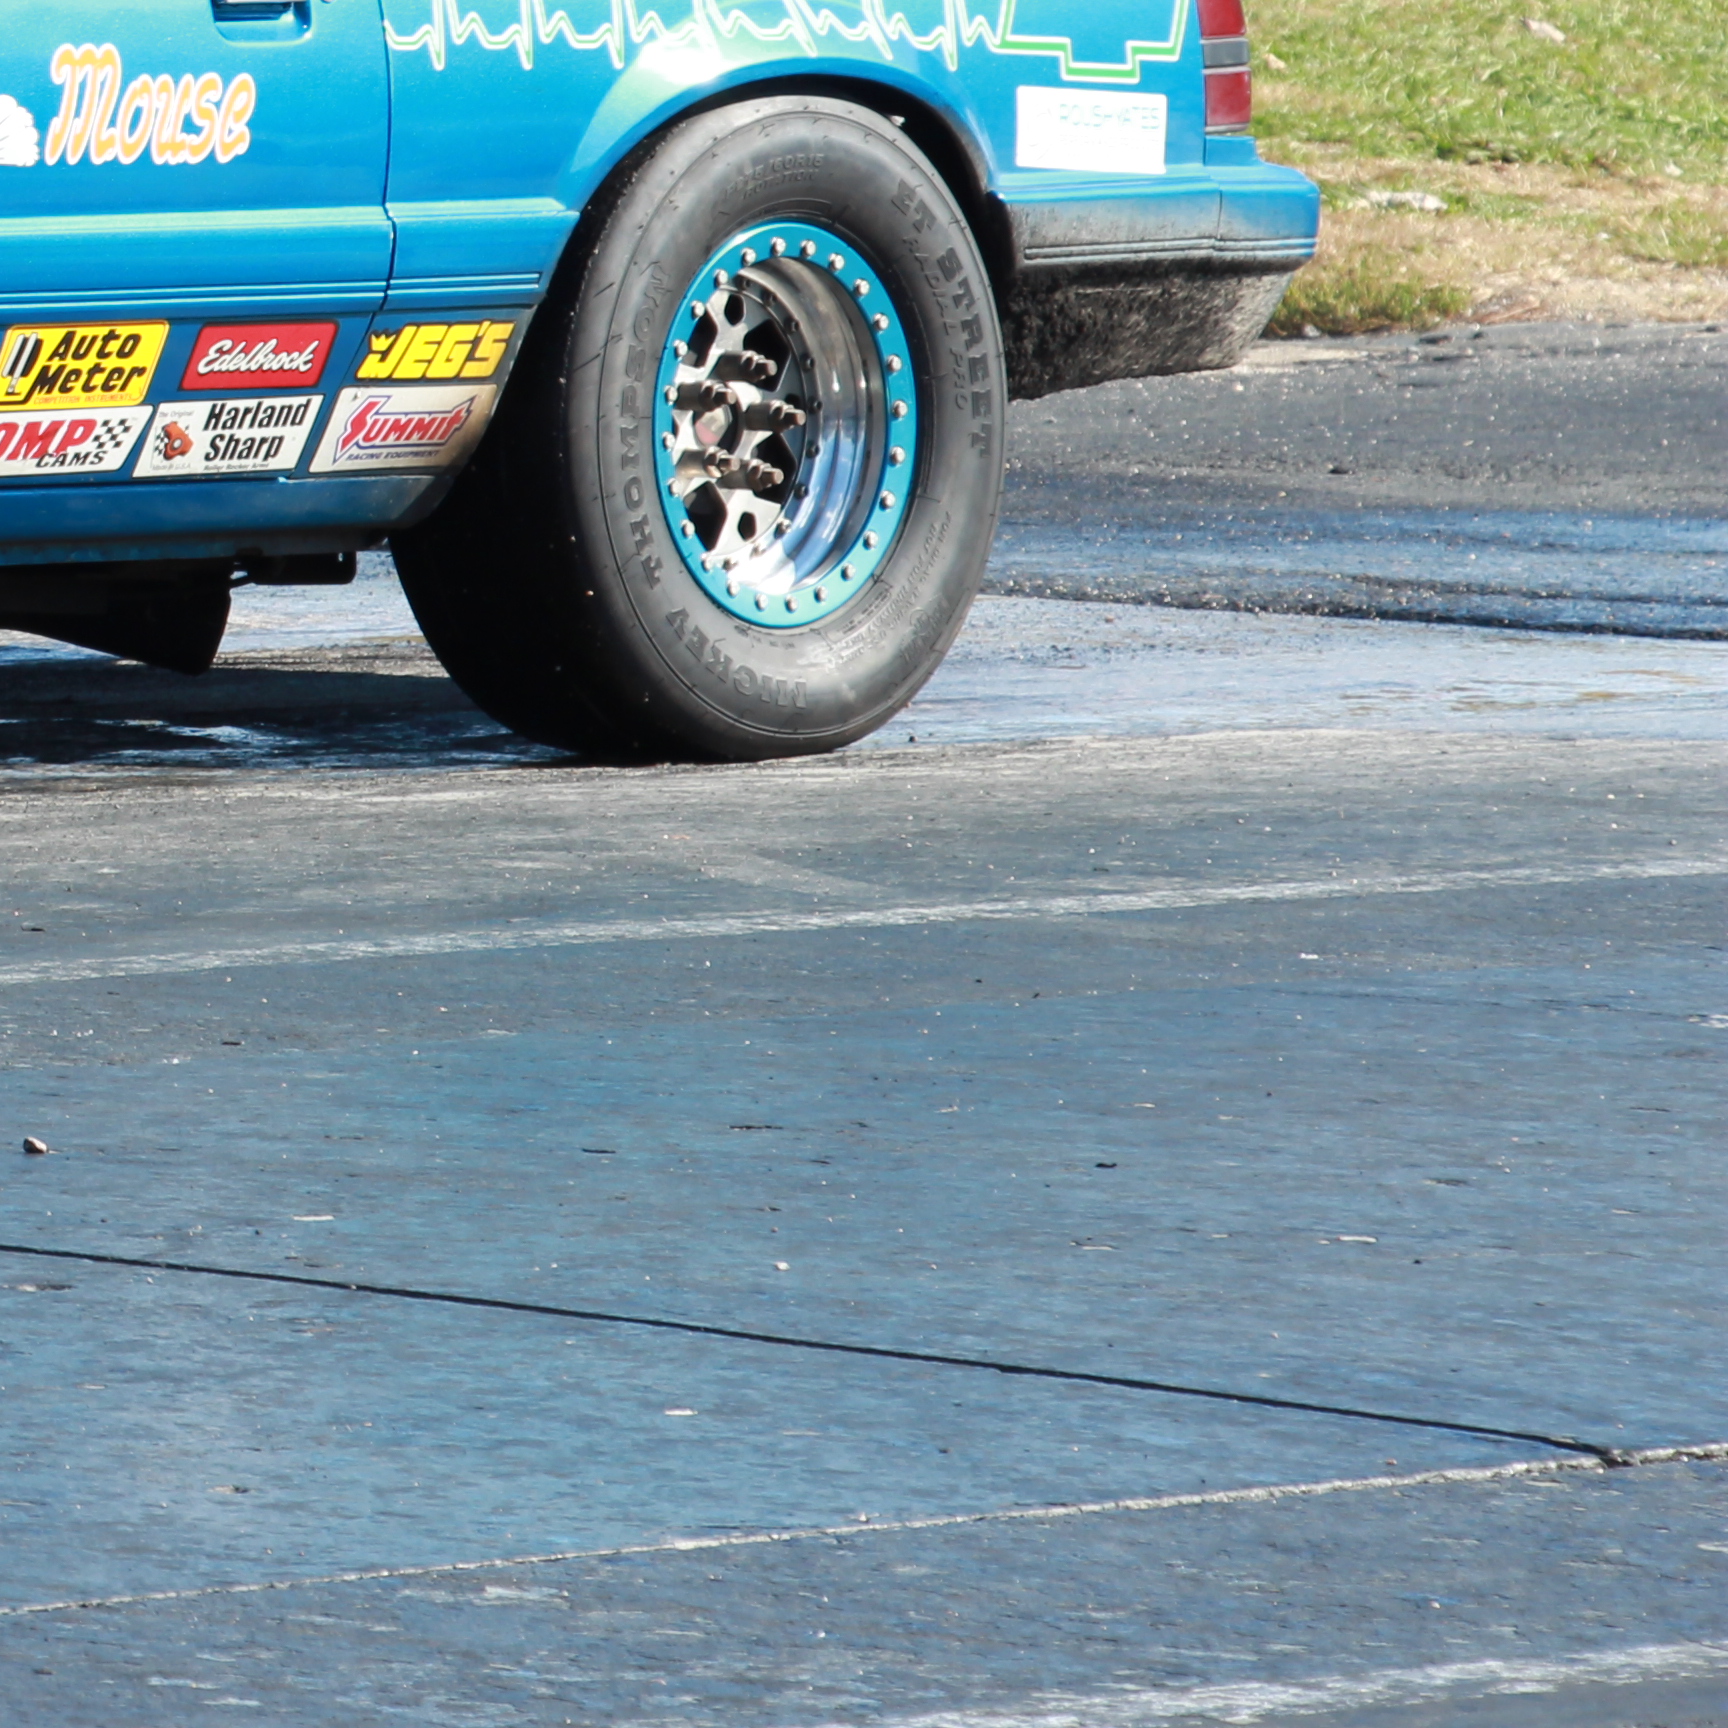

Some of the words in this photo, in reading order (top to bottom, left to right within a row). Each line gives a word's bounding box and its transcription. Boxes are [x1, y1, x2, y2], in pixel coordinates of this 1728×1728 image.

[45, 42, 256, 166] Mouse
[45, 329, 142, 362] Auto
[197, 339, 316, 376] Edelbrock
[356, 320, 516, 380] JEG'S
[936, 246, 992, 458] STREET
[34, 362, 148, 394] Meter
[202, 398, 312, 432] Harland
[619, 258, 673, 591] THOMPSON
[34, 450, 108, 468] CAMS
[204, 433, 285, 462] Sharp
[346, 451, 384, 461] RACING
[384, 449, 441, 460] EQUIPMENT
[664, 605, 808, 710] MICKEY
